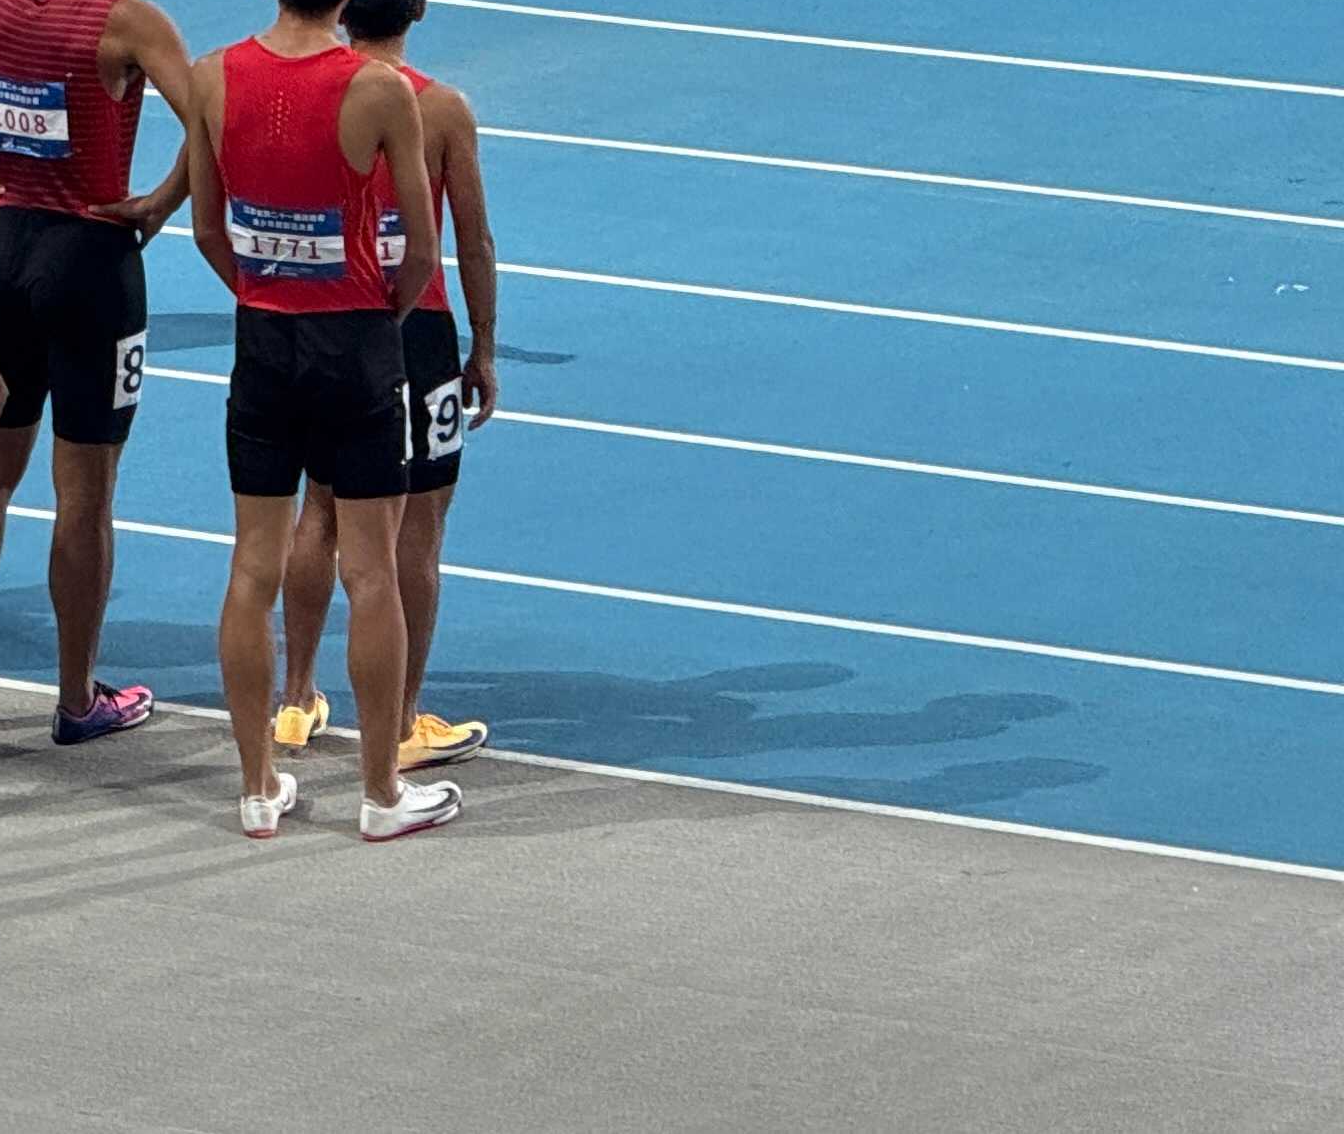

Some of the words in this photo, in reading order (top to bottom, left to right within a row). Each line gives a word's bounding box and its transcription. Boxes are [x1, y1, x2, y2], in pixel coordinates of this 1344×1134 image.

[250, 234, 322, 260] 1771
[123, 344, 144, 394] 8
[436, 393, 460, 443] 9
